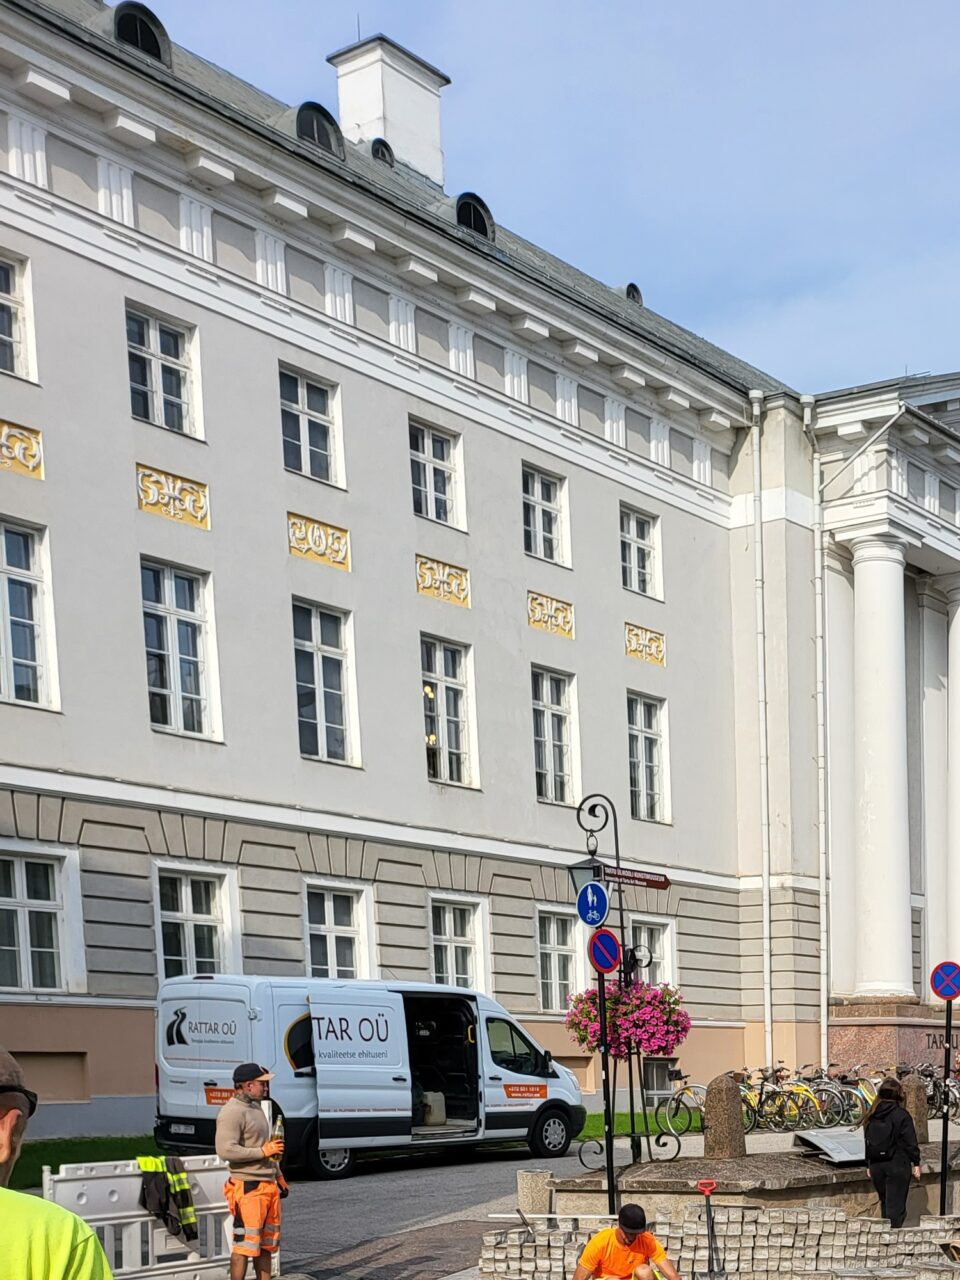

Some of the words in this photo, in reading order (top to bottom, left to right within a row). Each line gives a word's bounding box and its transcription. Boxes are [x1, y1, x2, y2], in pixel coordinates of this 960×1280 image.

[188, 1021, 220, 1035] RATTAR
[222, 1020, 237, 1035] OÜ
[359, 1013, 389, 1042] OÜ
[925, 1033, 959, 1050] TARU
[318, 1049, 357, 1059] kvaliteetse
[358, 1049, 389, 1059] ehituseni
